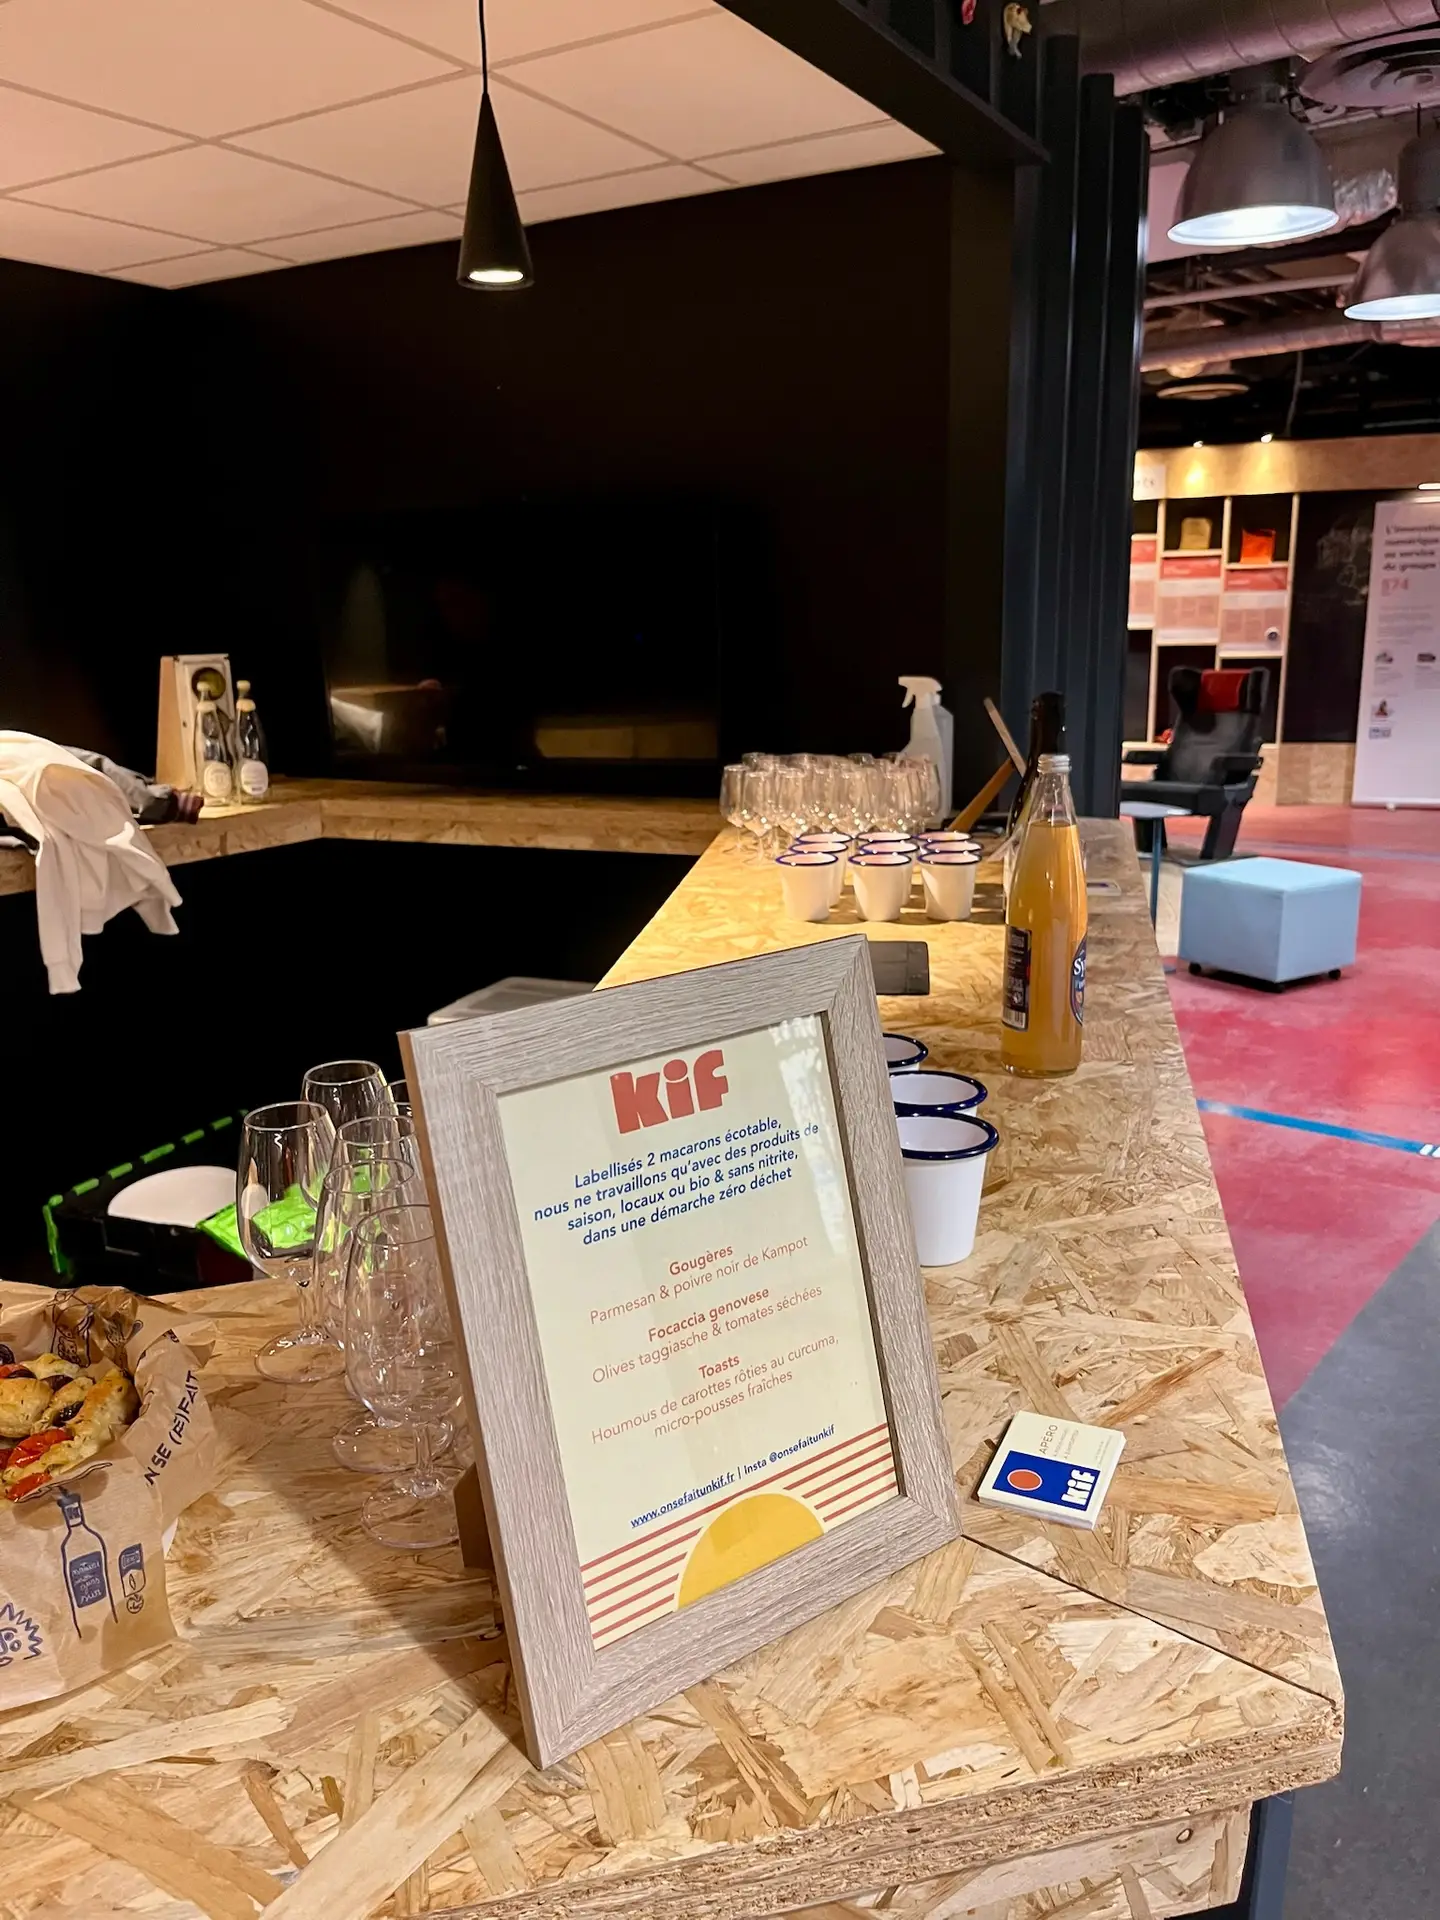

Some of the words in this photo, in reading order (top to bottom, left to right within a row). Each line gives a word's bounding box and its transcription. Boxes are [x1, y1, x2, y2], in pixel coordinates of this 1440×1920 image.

[610, 1049, 729, 1134] kif
[534, 1201, 569, 1221] nous
[574, 1194, 592, 1209] ne
[596, 1171, 667, 1202] travaillons
[725, 1145, 747, 1161] des
[750, 1128, 800, 1157] produits
[804, 1122, 819, 1137] de
[568, 1208, 616, 1231] saison,
[621, 1190, 665, 1214] locaux
[669, 1184, 685, 1198] ou
[689, 1175, 710, 1192] bio
[714, 1169, 724, 1183] &
[728, 1162, 755, 1179] sans
[758, 1149, 798, 1169] nitrite,
[575, 1157, 643, 1189] Labellisés
[647, 1152, 656, 1167] 2
[660, 1134, 721, 1163] macarons
[725, 1116, 782, 1143] écotable,
[583, 1226, 616, 1245] dans
[621, 1217, 646, 1233] une
[650, 1193, 715, 1223] démarche
[719, 1183, 746, 1201] zéro
[750, 1167, 792, 1190] déchet
[590, 1293, 656, 1325] Parmesan
[659, 1284, 670, 1300] &
[673, 1271, 713, 1298] poivre
[716, 1260, 740, 1279] noir
[743, 1254, 759, 1269] de
[761, 1236, 809, 1261] Kampot
[669, 1245, 733, 1276] Gougères
[592, 1359, 636, 1383] Olives
[639, 1331, 709, 1365] taggiasche
[712, 1322, 722, 1337] &
[725, 1304, 774, 1332] tomates
[777, 1286, 822, 1312] séchées
[648, 1312, 706, 1342] Focaccia
[709, 1288, 770, 1322] genovese
[592, 1408, 657, 1445] Houmous
[660, 1400, 678, 1415] de
[681, 1378, 731, 1407] carottes
[735, 1364, 768, 1385] rôties
[770, 1355, 785, 1369] au
[788, 1335, 839, 1362] curcuma,
[654, 1391, 744, 1438] micro-pousses
[747, 1370, 793, 1398] fraîches
[698, 1355, 740, 1379] Toasts
[144, 1465, 160, 1486] N
[151, 1442, 172, 1469] SE
[630, 1471, 736, 1529] www.onsefaitunkif.fr
[743, 1458, 767, 1476] Insta
[769, 1424, 836, 1463] @onsefaitunkif
